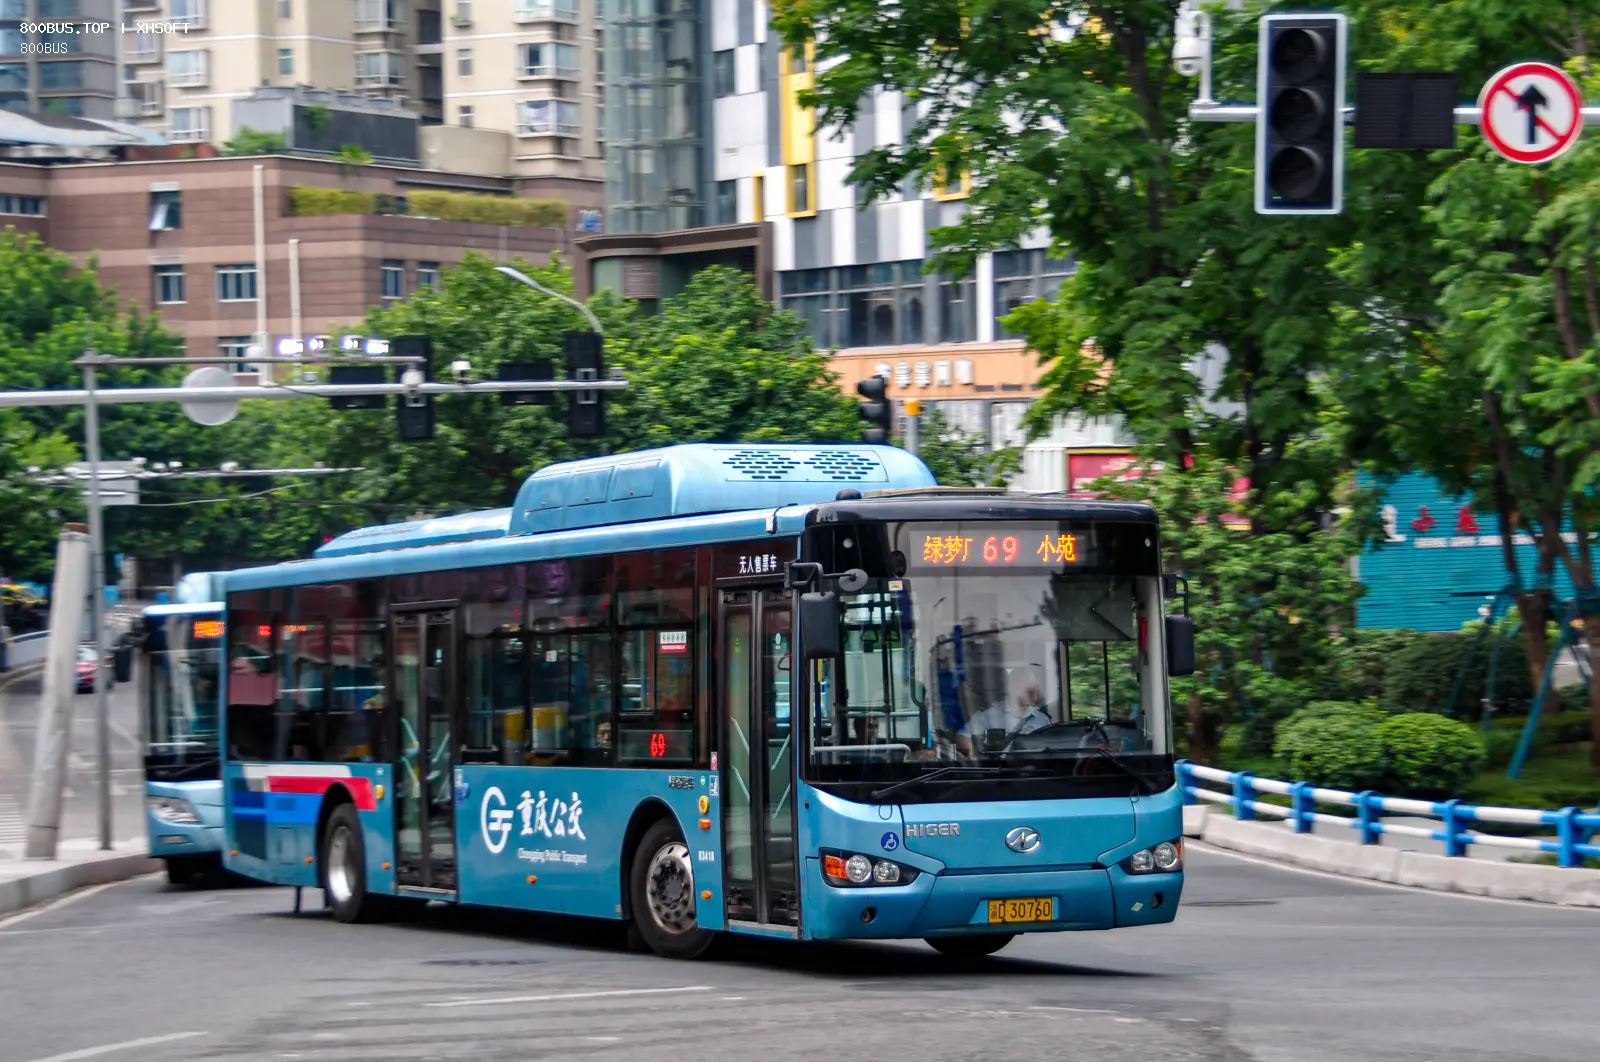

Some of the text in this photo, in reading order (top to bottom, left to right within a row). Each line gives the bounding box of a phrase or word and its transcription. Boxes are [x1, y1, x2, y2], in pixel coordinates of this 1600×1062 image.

[923, 534, 1077, 564] 绿梦厂 69 小苑
[739, 553, 777, 574] 无人售票车
[650, 732, 666, 758] 69
[905, 822, 961, 838] HIGER
